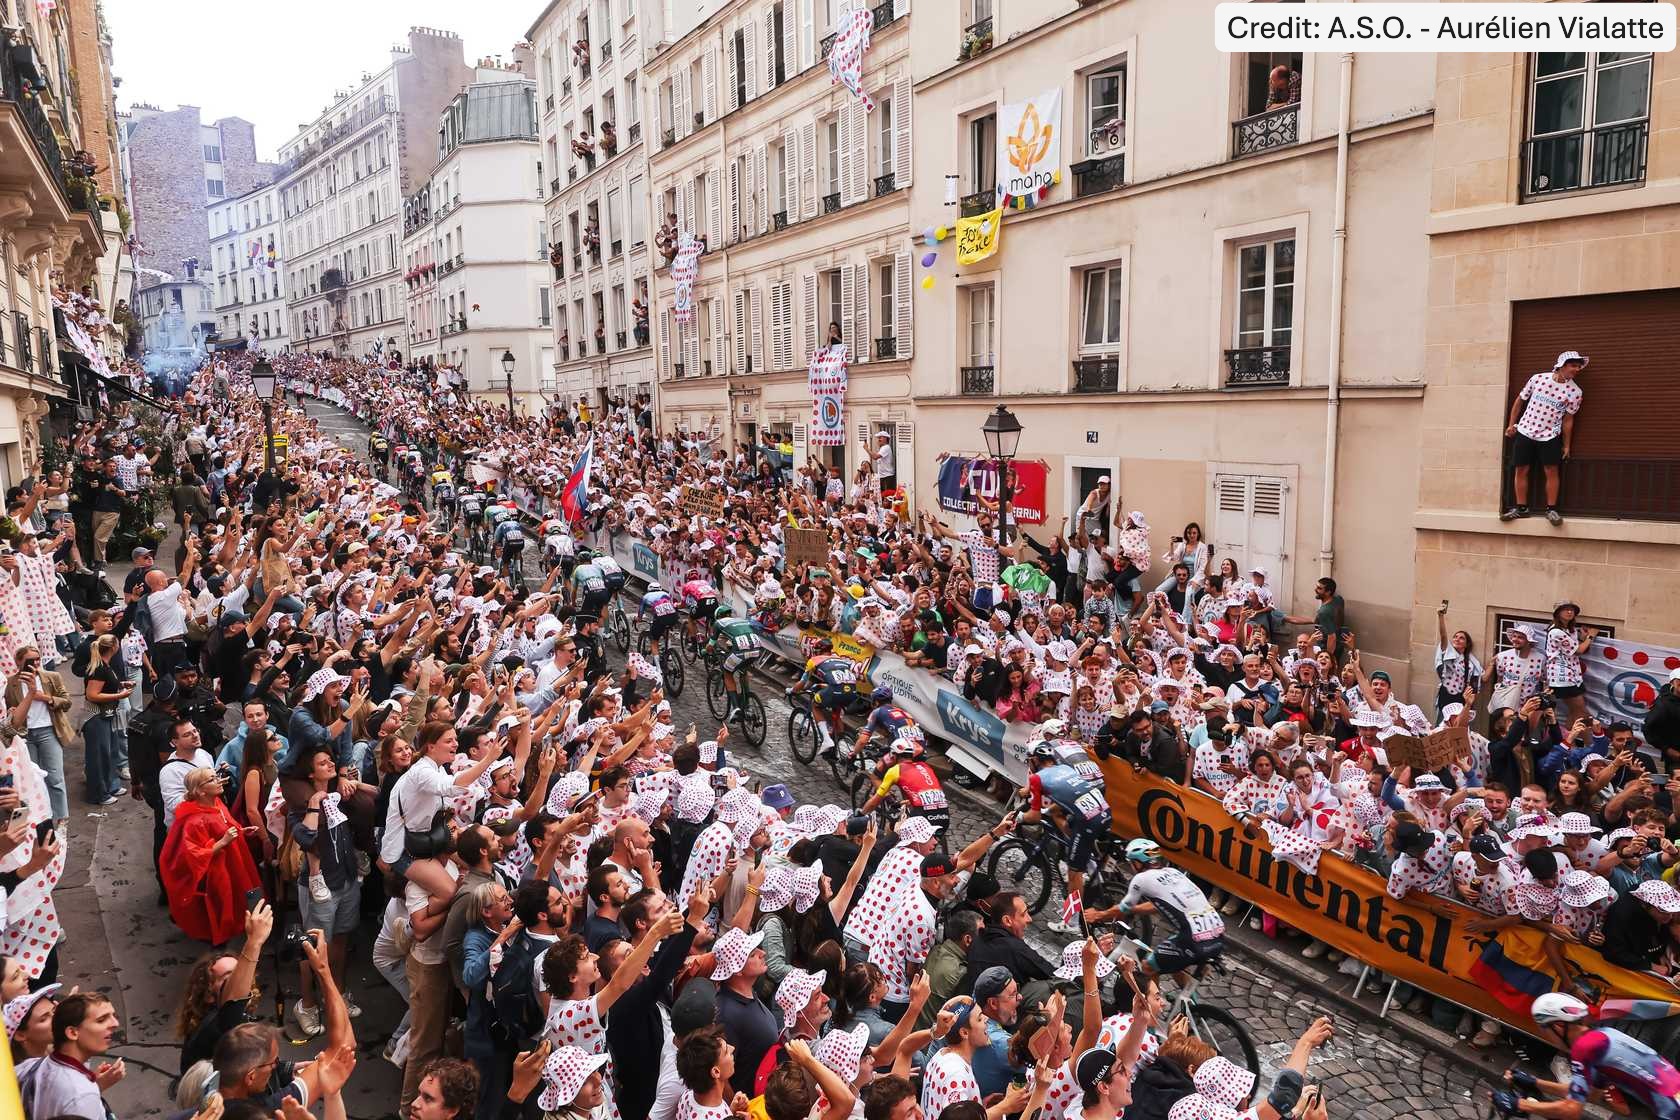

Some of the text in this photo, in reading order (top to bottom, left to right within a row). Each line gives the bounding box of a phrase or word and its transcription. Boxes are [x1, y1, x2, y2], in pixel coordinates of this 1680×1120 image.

[1088, 432, 1097, 443] 74
[943, 496, 977, 512] COLLECTIF
[890, 684, 922, 704] AUDITION
[946, 701, 991, 746] Krys
[1137, 789, 1451, 974] Continental
[1091, 1064, 1110, 1086] FAEMA
